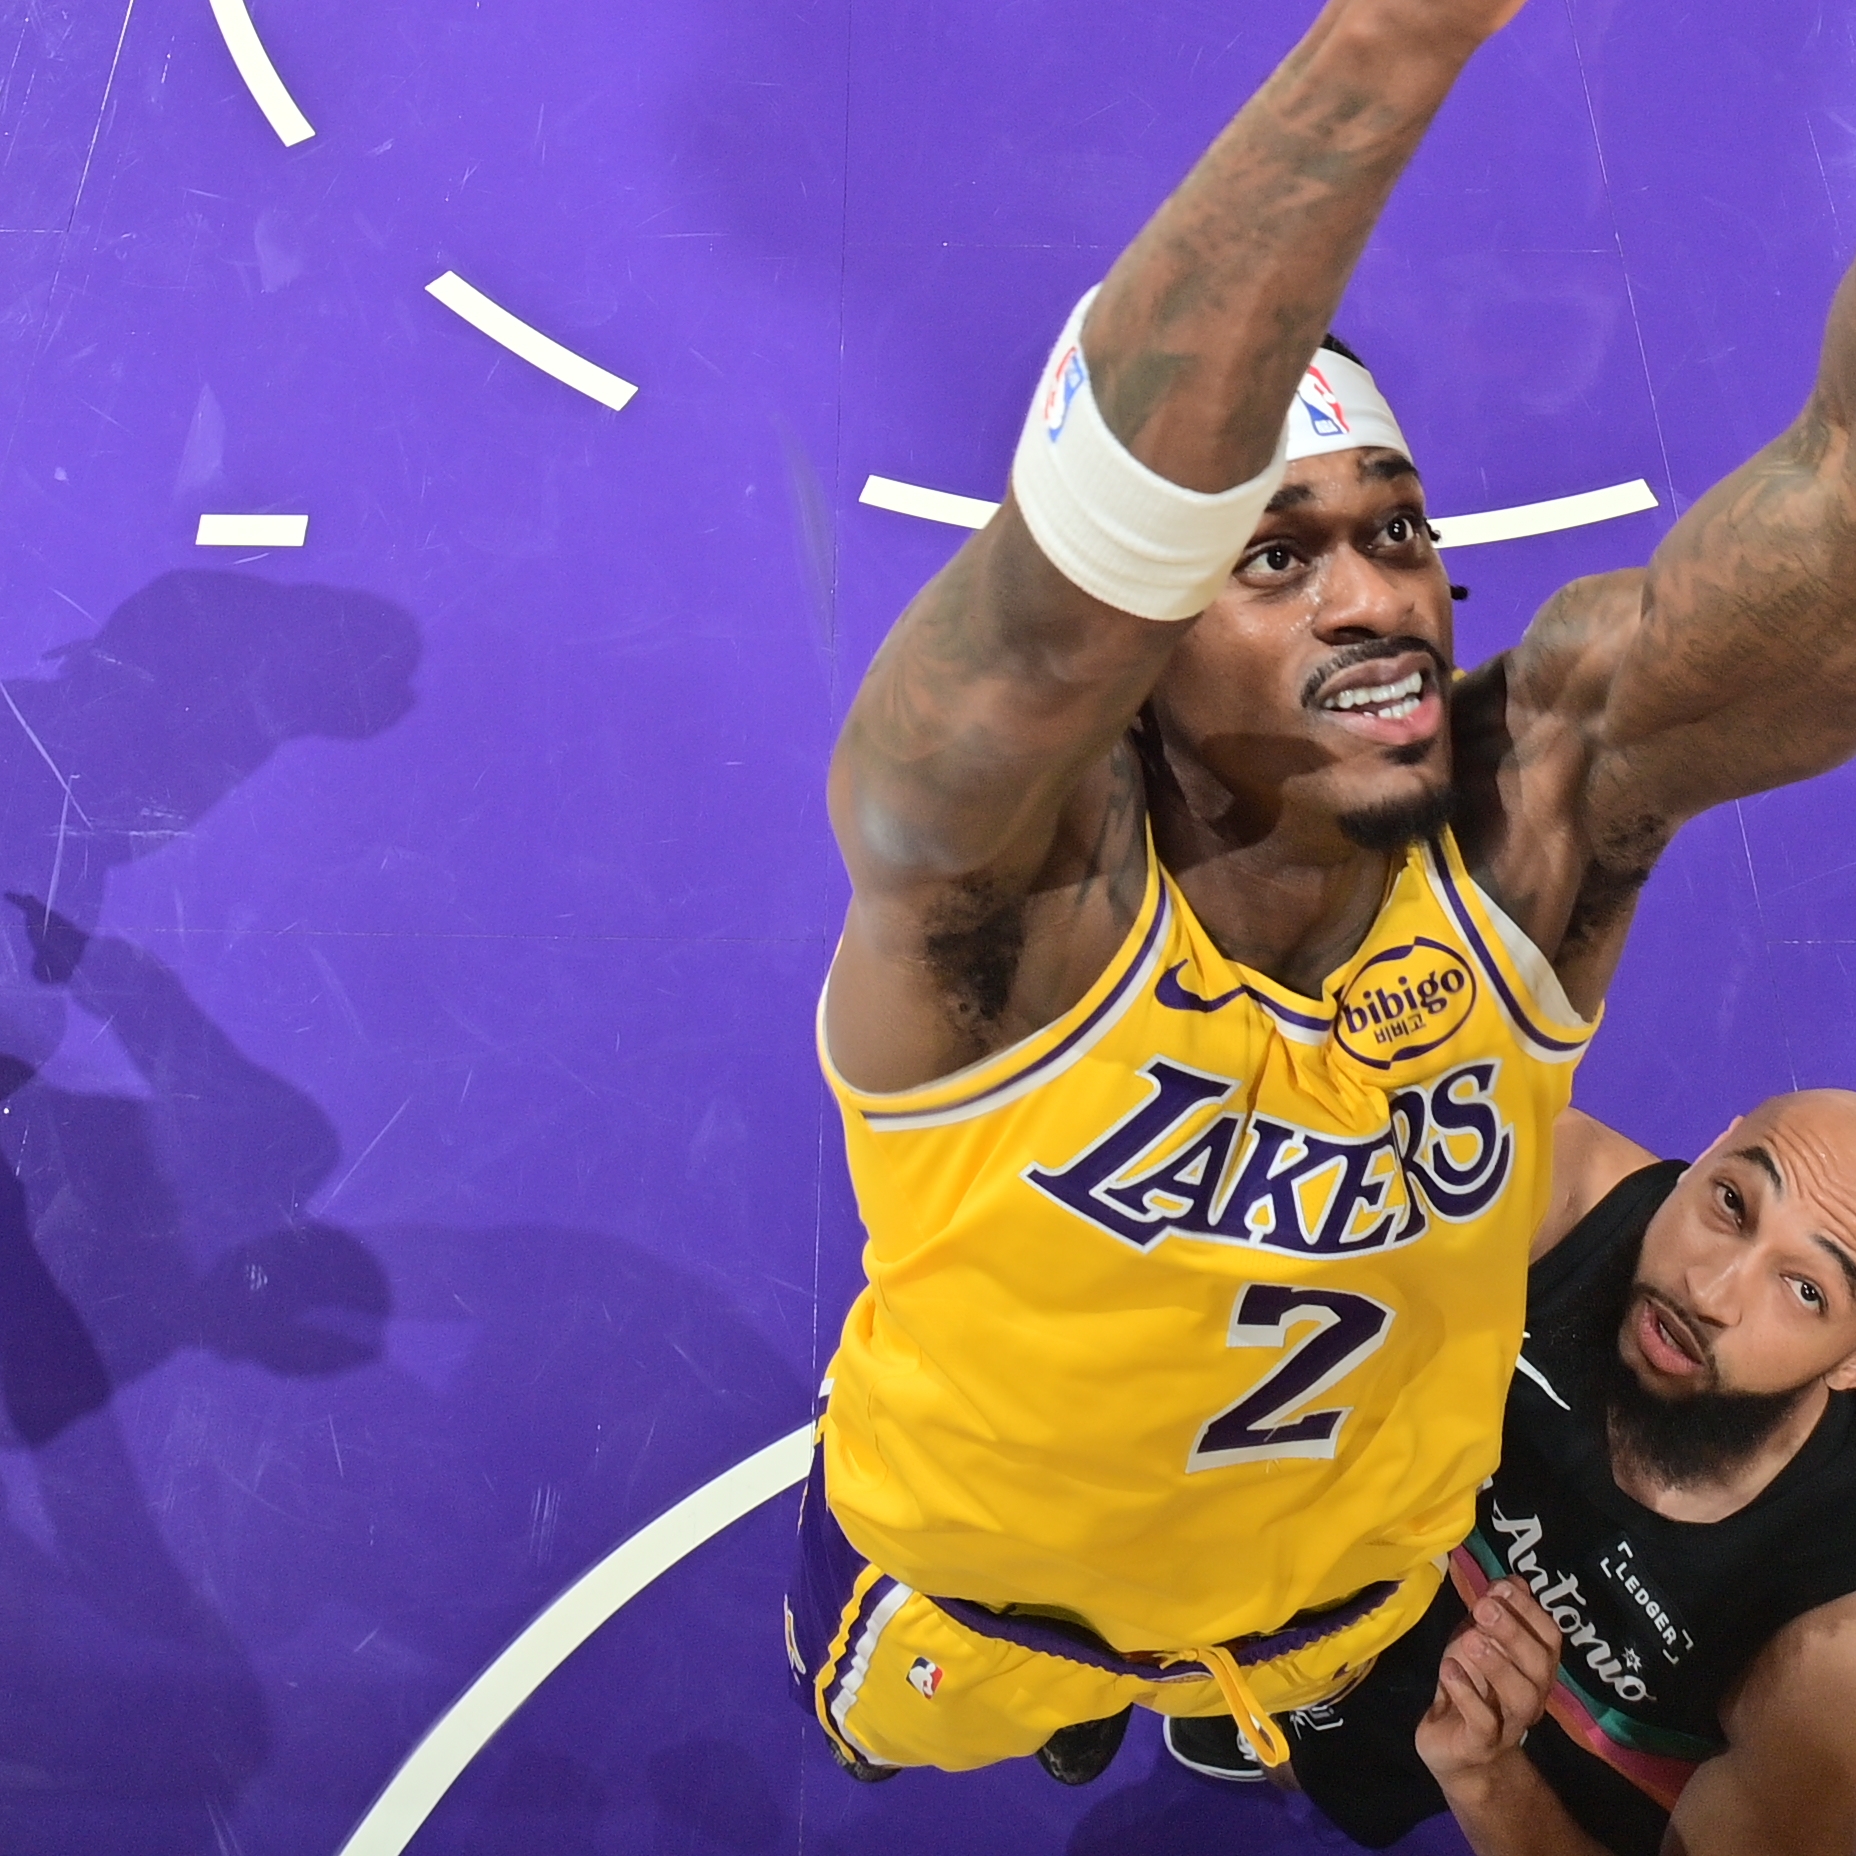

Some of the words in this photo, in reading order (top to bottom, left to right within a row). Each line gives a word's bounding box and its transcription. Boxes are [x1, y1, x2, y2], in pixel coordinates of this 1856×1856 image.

[1341, 968, 1466, 1034] bibigo
[1373, 1012, 1427, 1045] 비비고
[1019, 1052, 1515, 1261] LAKERS
[1184, 1280, 1397, 1475] 2
[1491, 1498, 1658, 1702] Antonio
[1615, 1561, 1678, 1647] LEDGER
